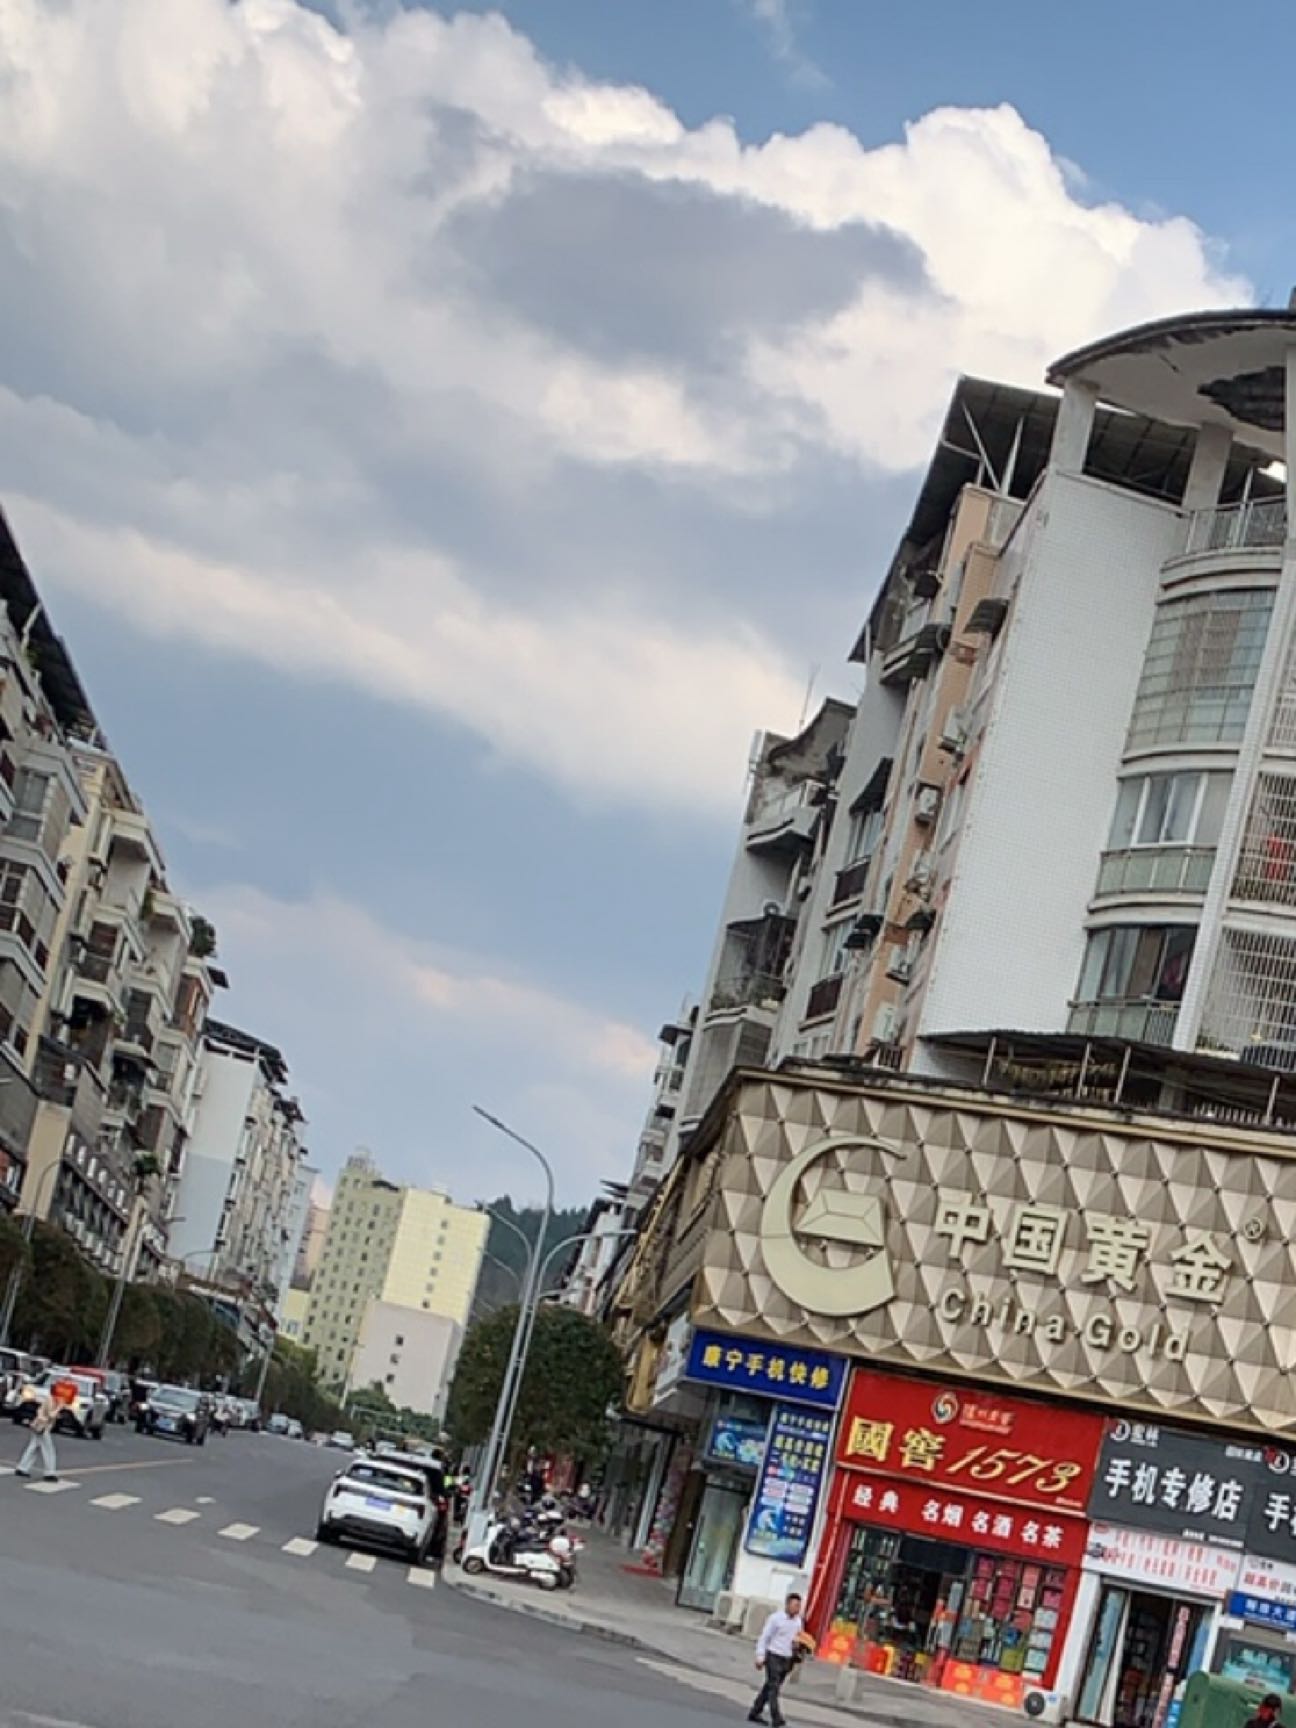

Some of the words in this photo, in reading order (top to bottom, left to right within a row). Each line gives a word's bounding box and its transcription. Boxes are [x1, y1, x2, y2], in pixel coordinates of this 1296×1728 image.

[935, 1193, 1232, 1304] 中国黄金
[940, 1288, 1066, 1342] China
[1085, 1314, 1190, 1362] Gold
[1104, 1458, 1244, 1521] 手机专修店
